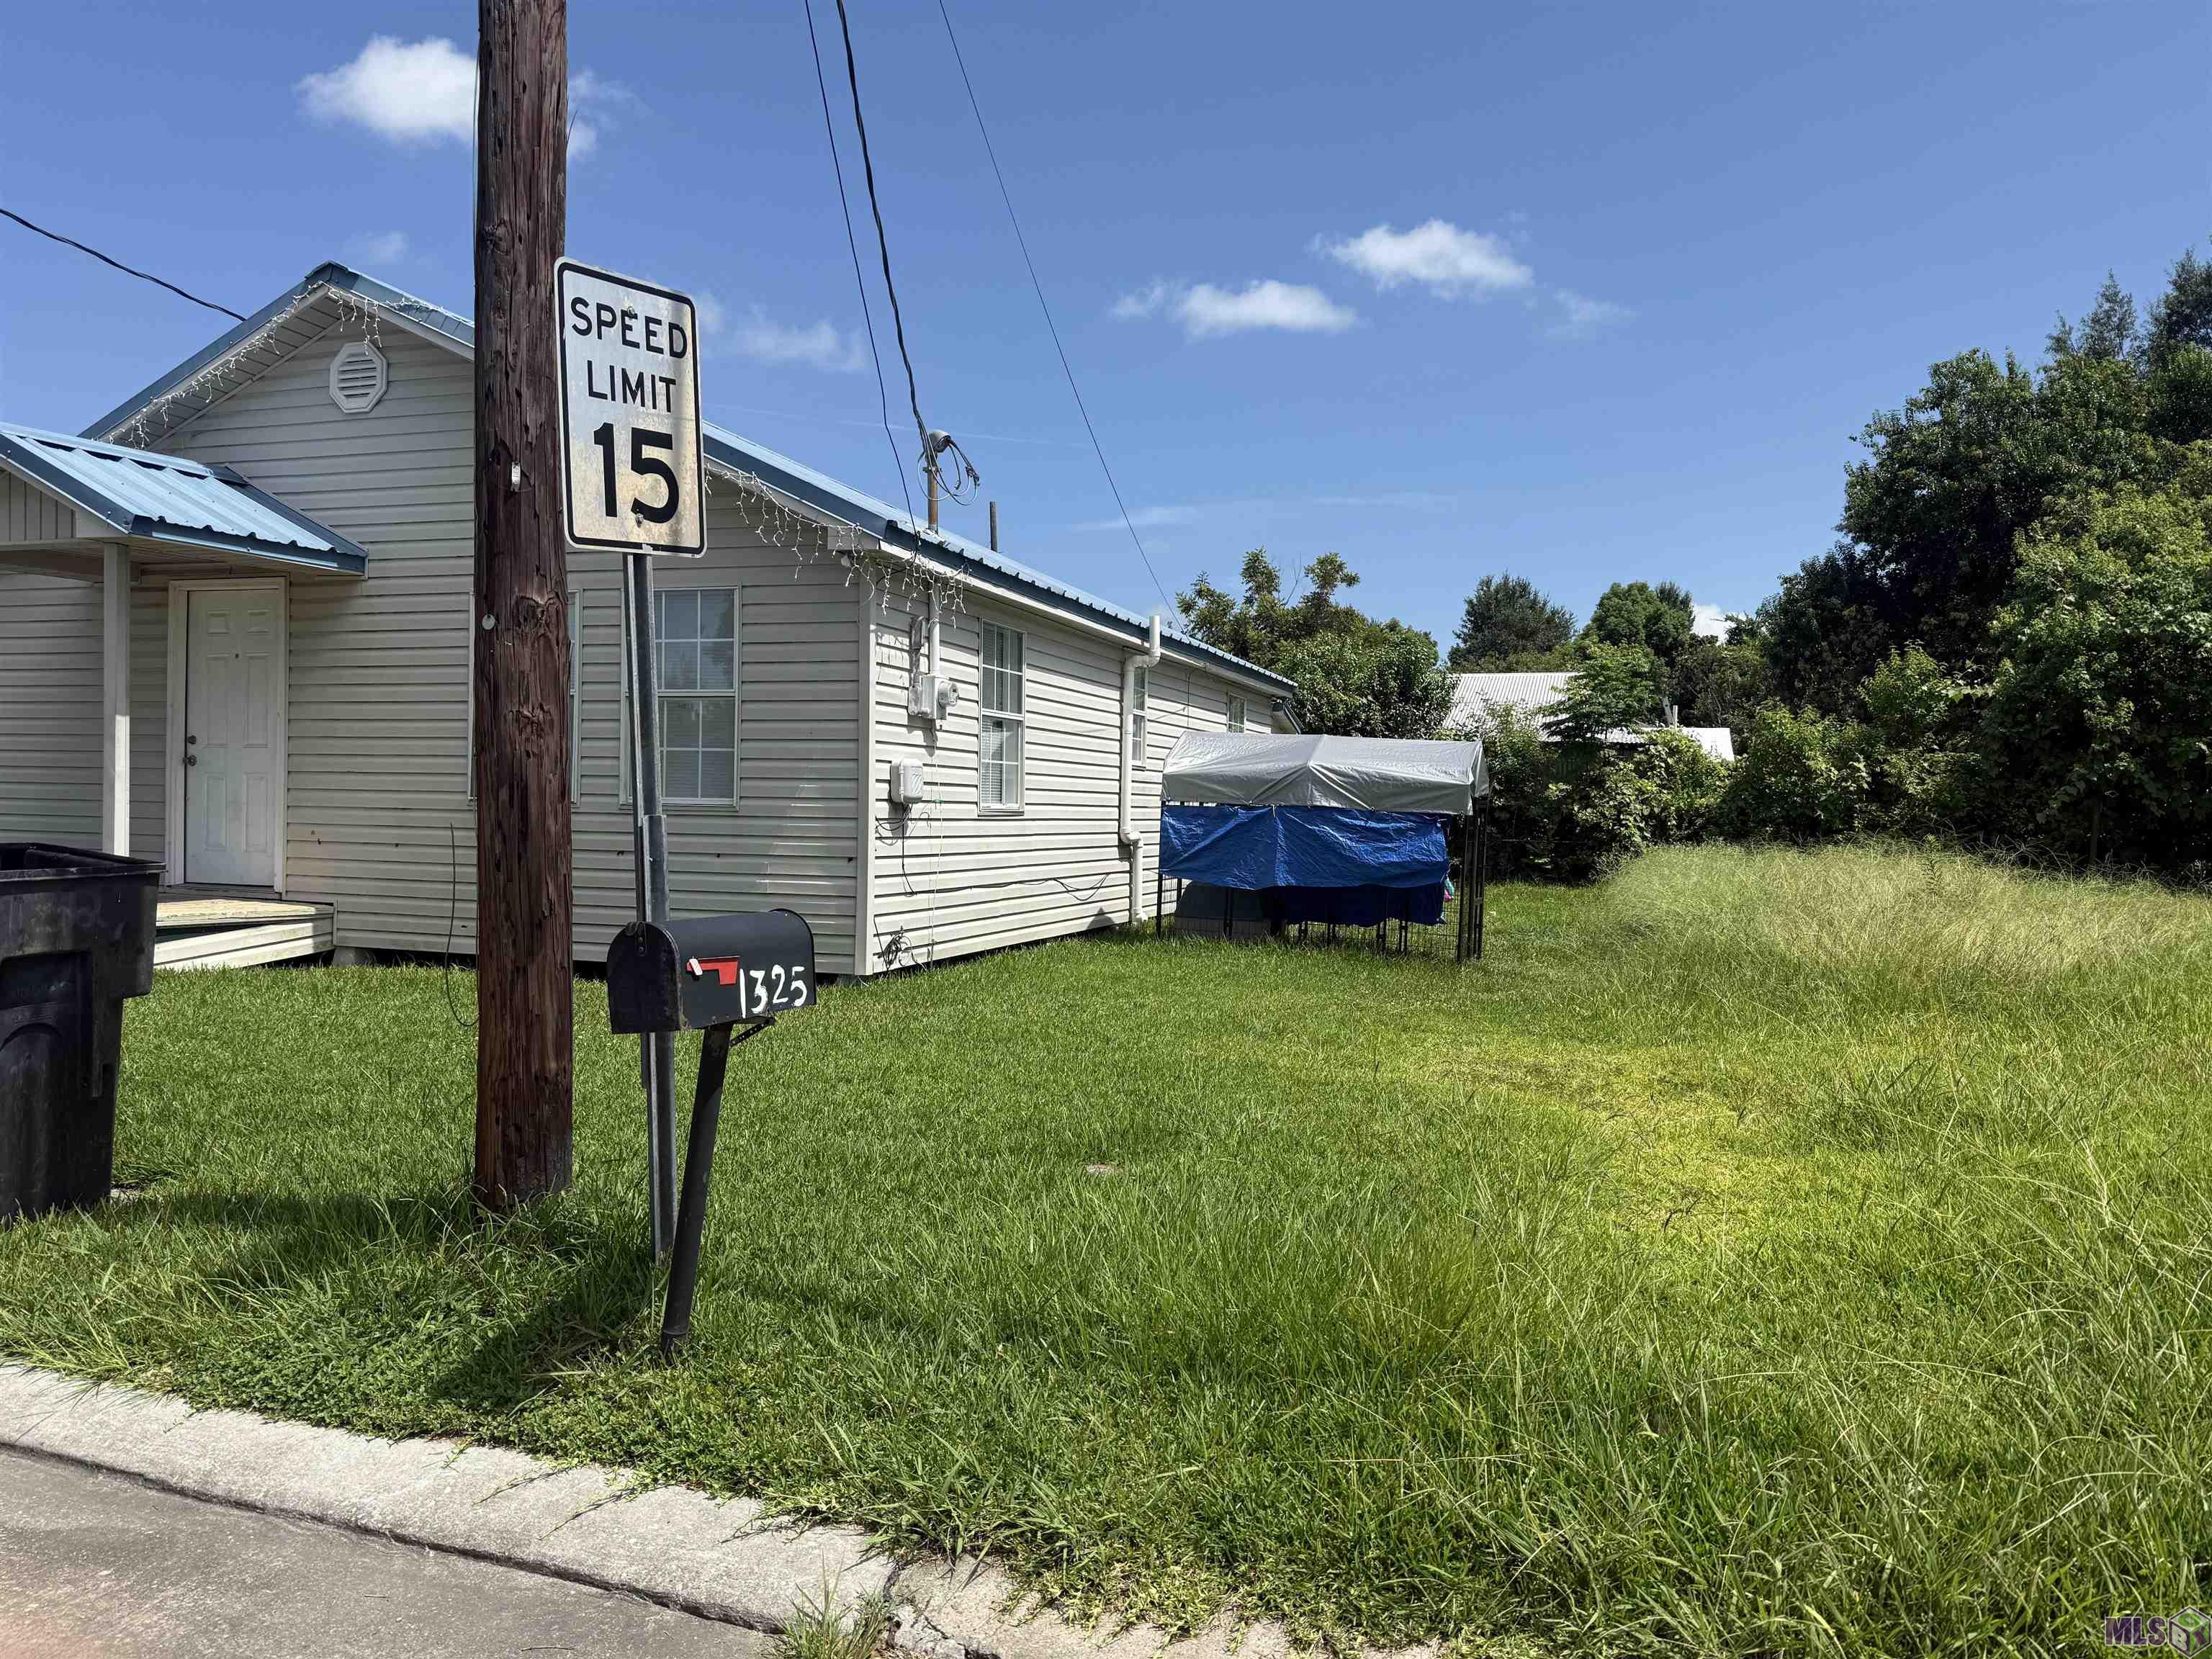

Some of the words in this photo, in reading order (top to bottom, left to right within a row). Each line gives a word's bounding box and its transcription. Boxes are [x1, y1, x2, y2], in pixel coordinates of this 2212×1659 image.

[570, 297, 688, 359] SPEED
[587, 359, 676, 413] LIMIT
[593, 422, 679, 524] 15
[739, 964, 807, 1019] 1325
